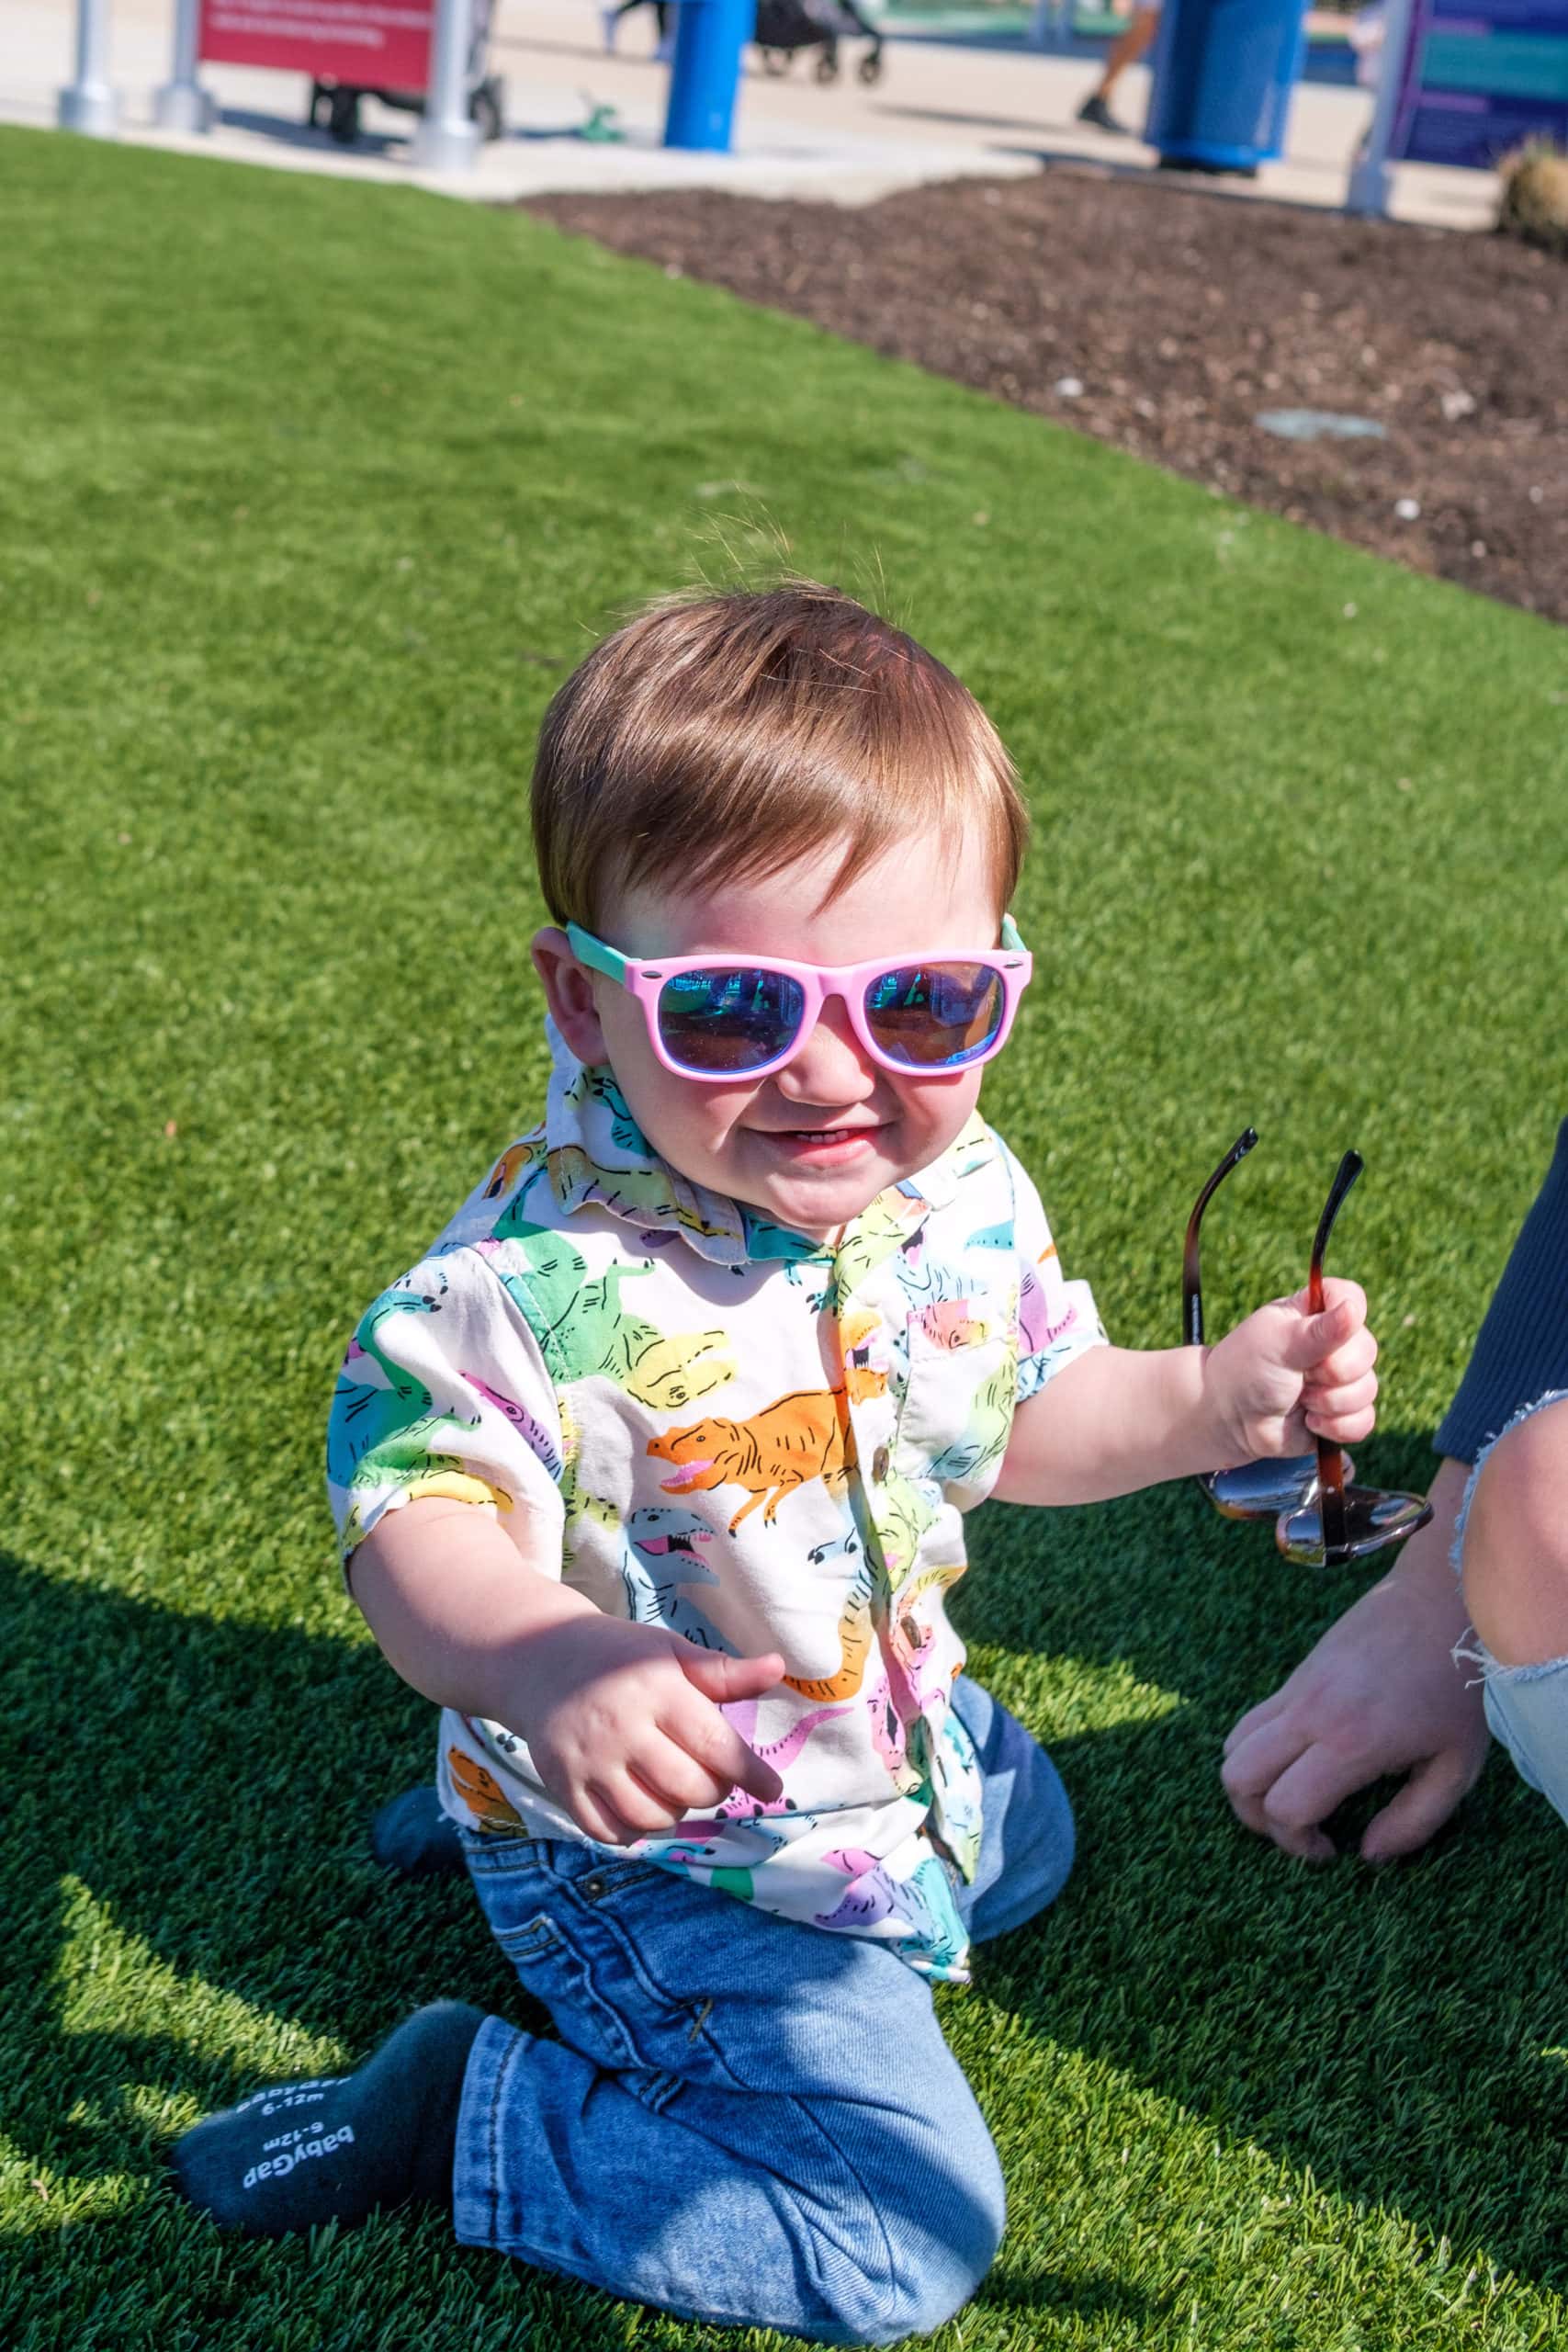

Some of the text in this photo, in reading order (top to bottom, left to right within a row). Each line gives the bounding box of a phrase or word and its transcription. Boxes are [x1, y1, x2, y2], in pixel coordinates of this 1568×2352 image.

[236, 2076, 353, 2113] babyG
[261, 2092, 324, 2116] 6-12m
[263, 2121, 324, 2152] 6-12m
[243, 2125, 355, 2188] babyGap
